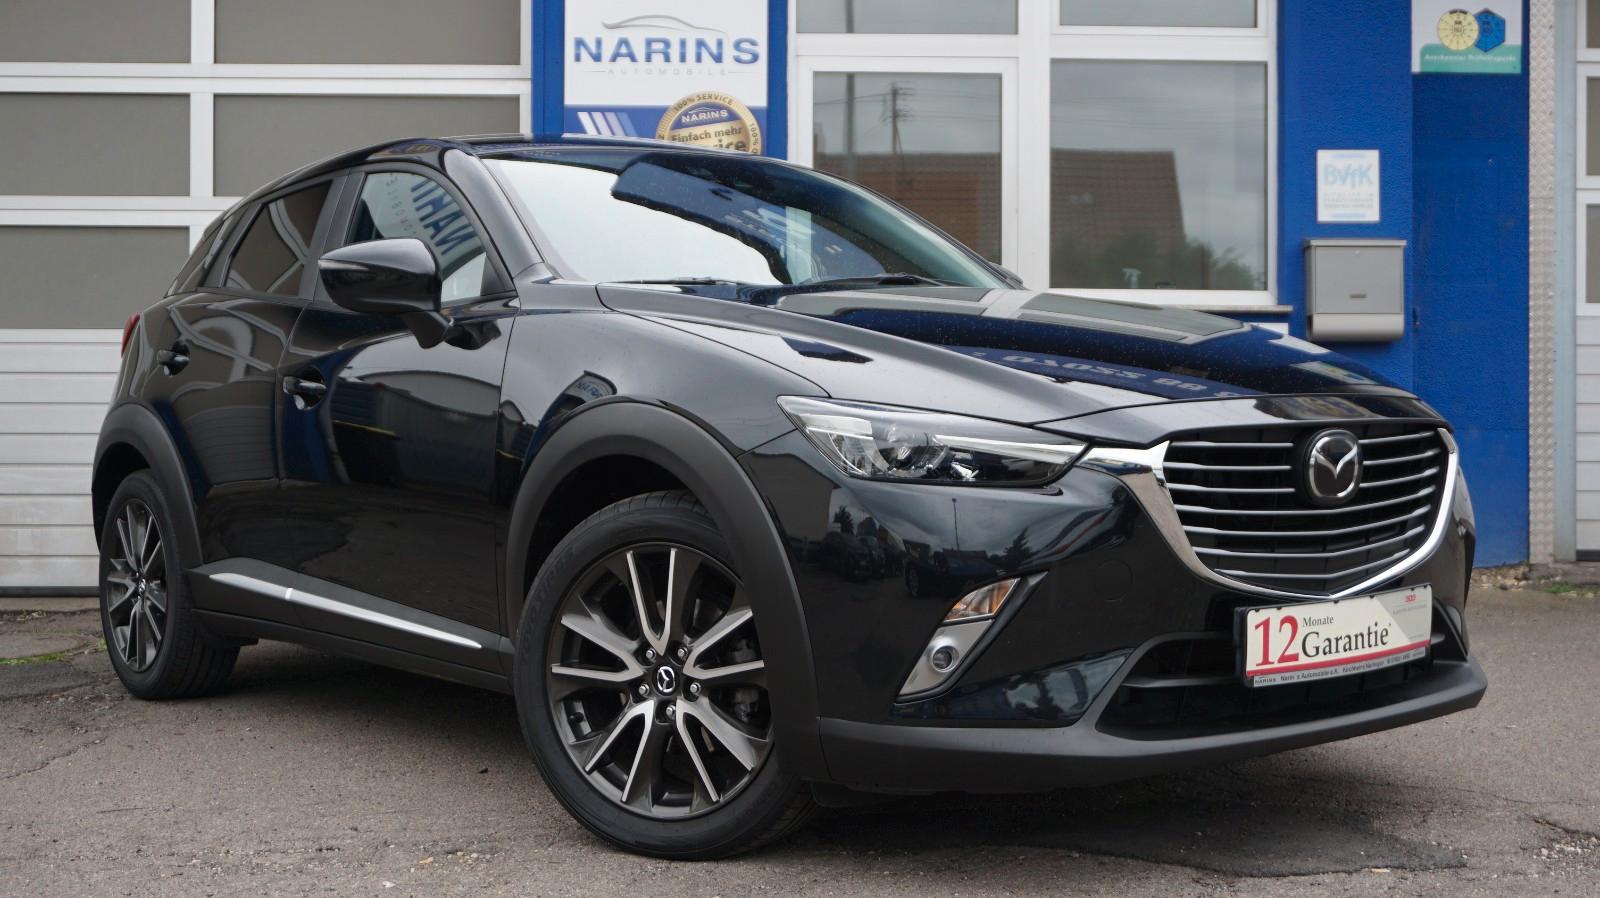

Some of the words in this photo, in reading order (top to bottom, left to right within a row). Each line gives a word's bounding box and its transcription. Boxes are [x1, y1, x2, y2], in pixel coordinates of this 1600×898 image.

[574, 37, 759, 64] NARINS
[673, 97, 695, 112] 100%
[696, 92, 734, 107] SERVICE
[682, 109, 728, 123] NARINS
[671, 130, 712, 143] Einfach
[714, 125, 743, 137] mehr
[1254, 615, 1299, 667] 12
[1302, 616, 1334, 628] Monate
